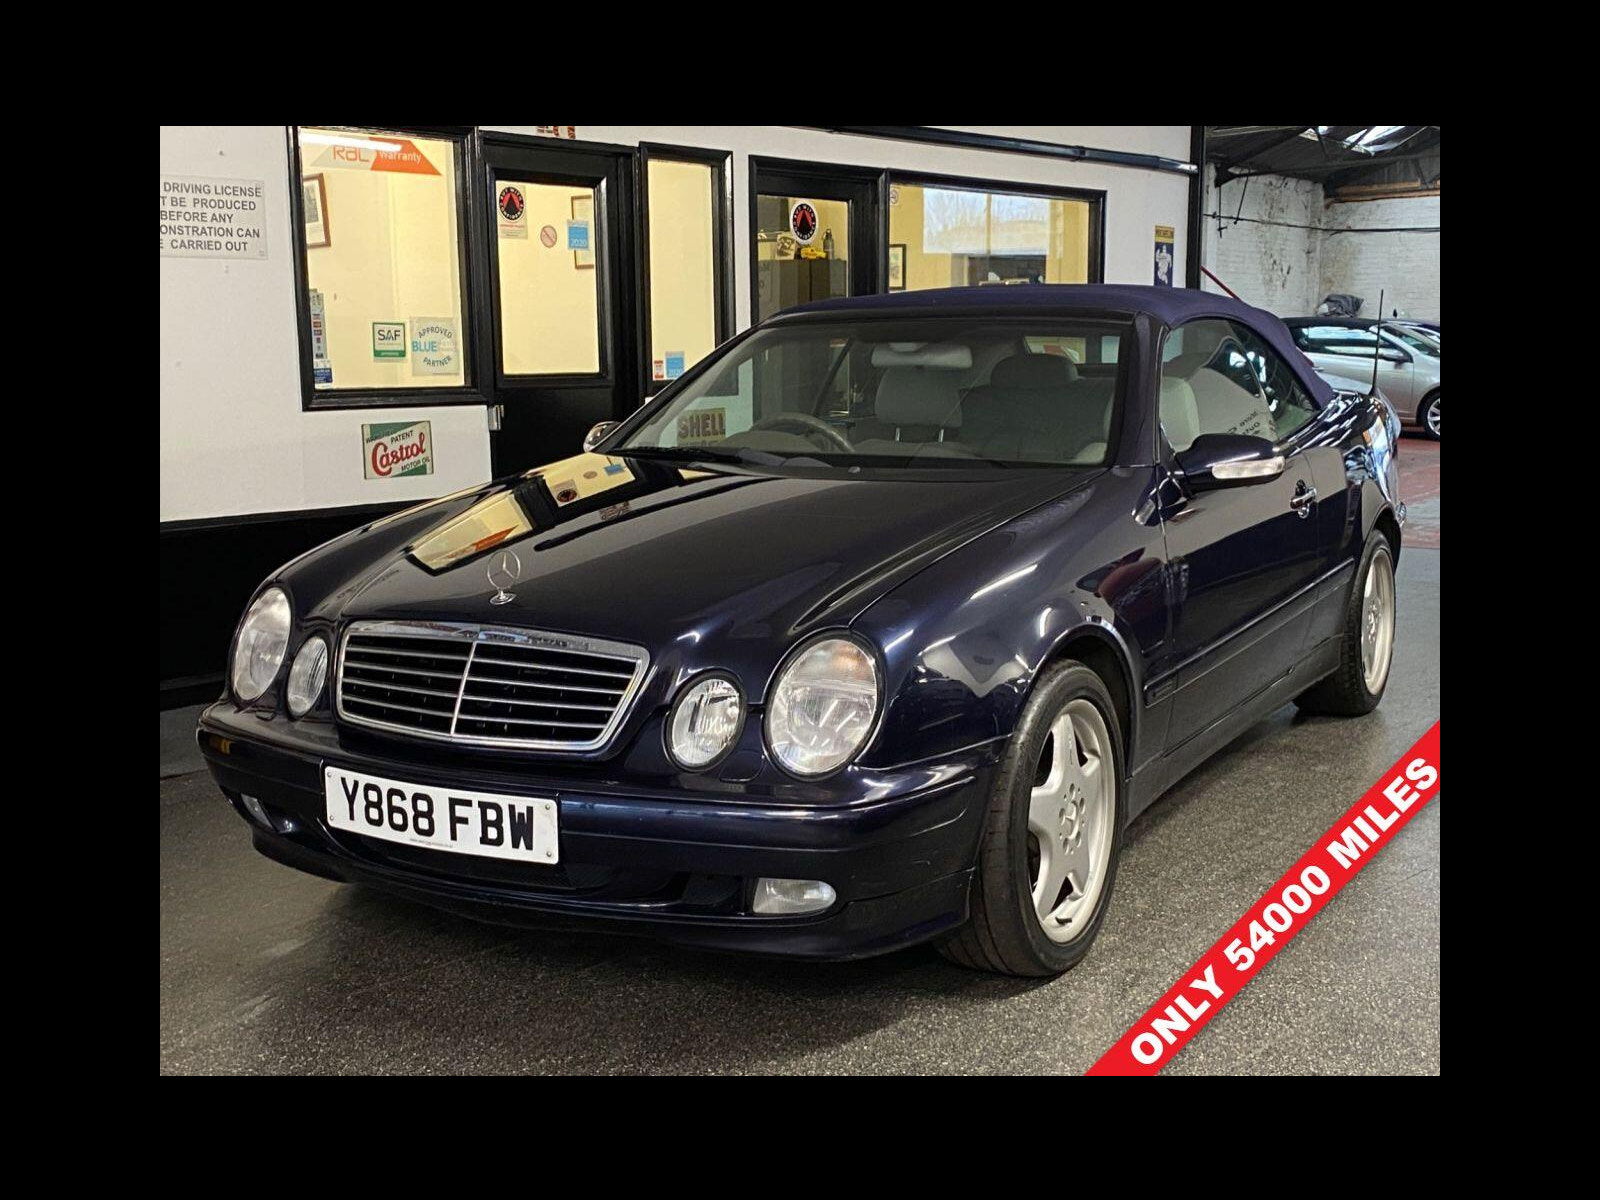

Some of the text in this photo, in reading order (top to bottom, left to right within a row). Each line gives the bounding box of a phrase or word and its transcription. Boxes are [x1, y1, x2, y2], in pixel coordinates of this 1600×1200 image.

[163, 182, 262, 197] DRIVING LICENSE
[171, 196, 186, 207] BE
[193, 198, 257, 211] PRODUCED
[160, 210, 234, 223] BEFORE ANY
[236, 228, 260, 238] CAN
[170, 239, 222, 251] CARRIED
[225, 241, 249, 252] OUT
[377, 329, 401, 341] SAF
[418, 326, 453, 339] APPROVED
[412, 340, 438, 352] BLUE
[679, 412, 726, 439] SHELL
[390, 430, 414, 444] PATENT
[372, 432, 426, 476] Castrol
[401, 459, 421, 471] MOTOR
[340, 777, 534, 851] Y868 FBW
